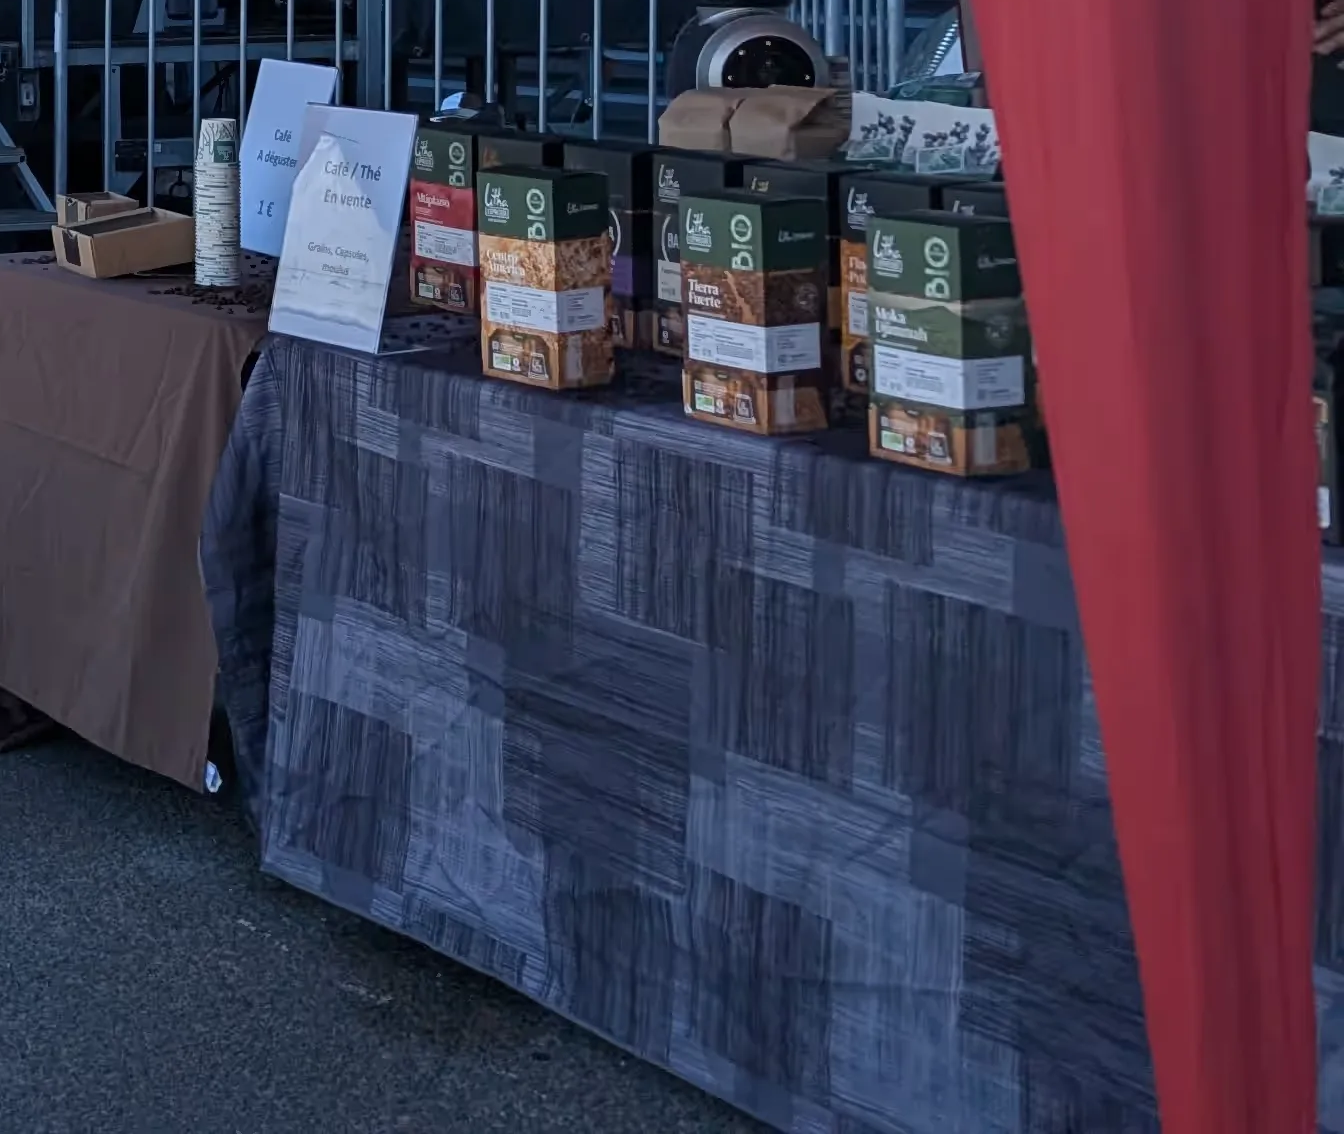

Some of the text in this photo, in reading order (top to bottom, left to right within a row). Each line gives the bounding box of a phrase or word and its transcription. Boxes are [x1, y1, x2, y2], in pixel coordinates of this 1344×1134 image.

[274, 128, 292, 143] Café
[324, 160, 349, 177] Café
[360, 164, 381, 182] Thé
[448, 142, 466, 187] BIO
[257, 200, 275, 218] 1 €
[323, 189, 372, 209] En vente
[526, 188, 546, 241] BIO
[730, 214, 754, 271] BIO
[924, 236, 950, 299] BIO
[688, 278, 719, 296] Tierra
[688, 291, 721, 309] Fuerte
